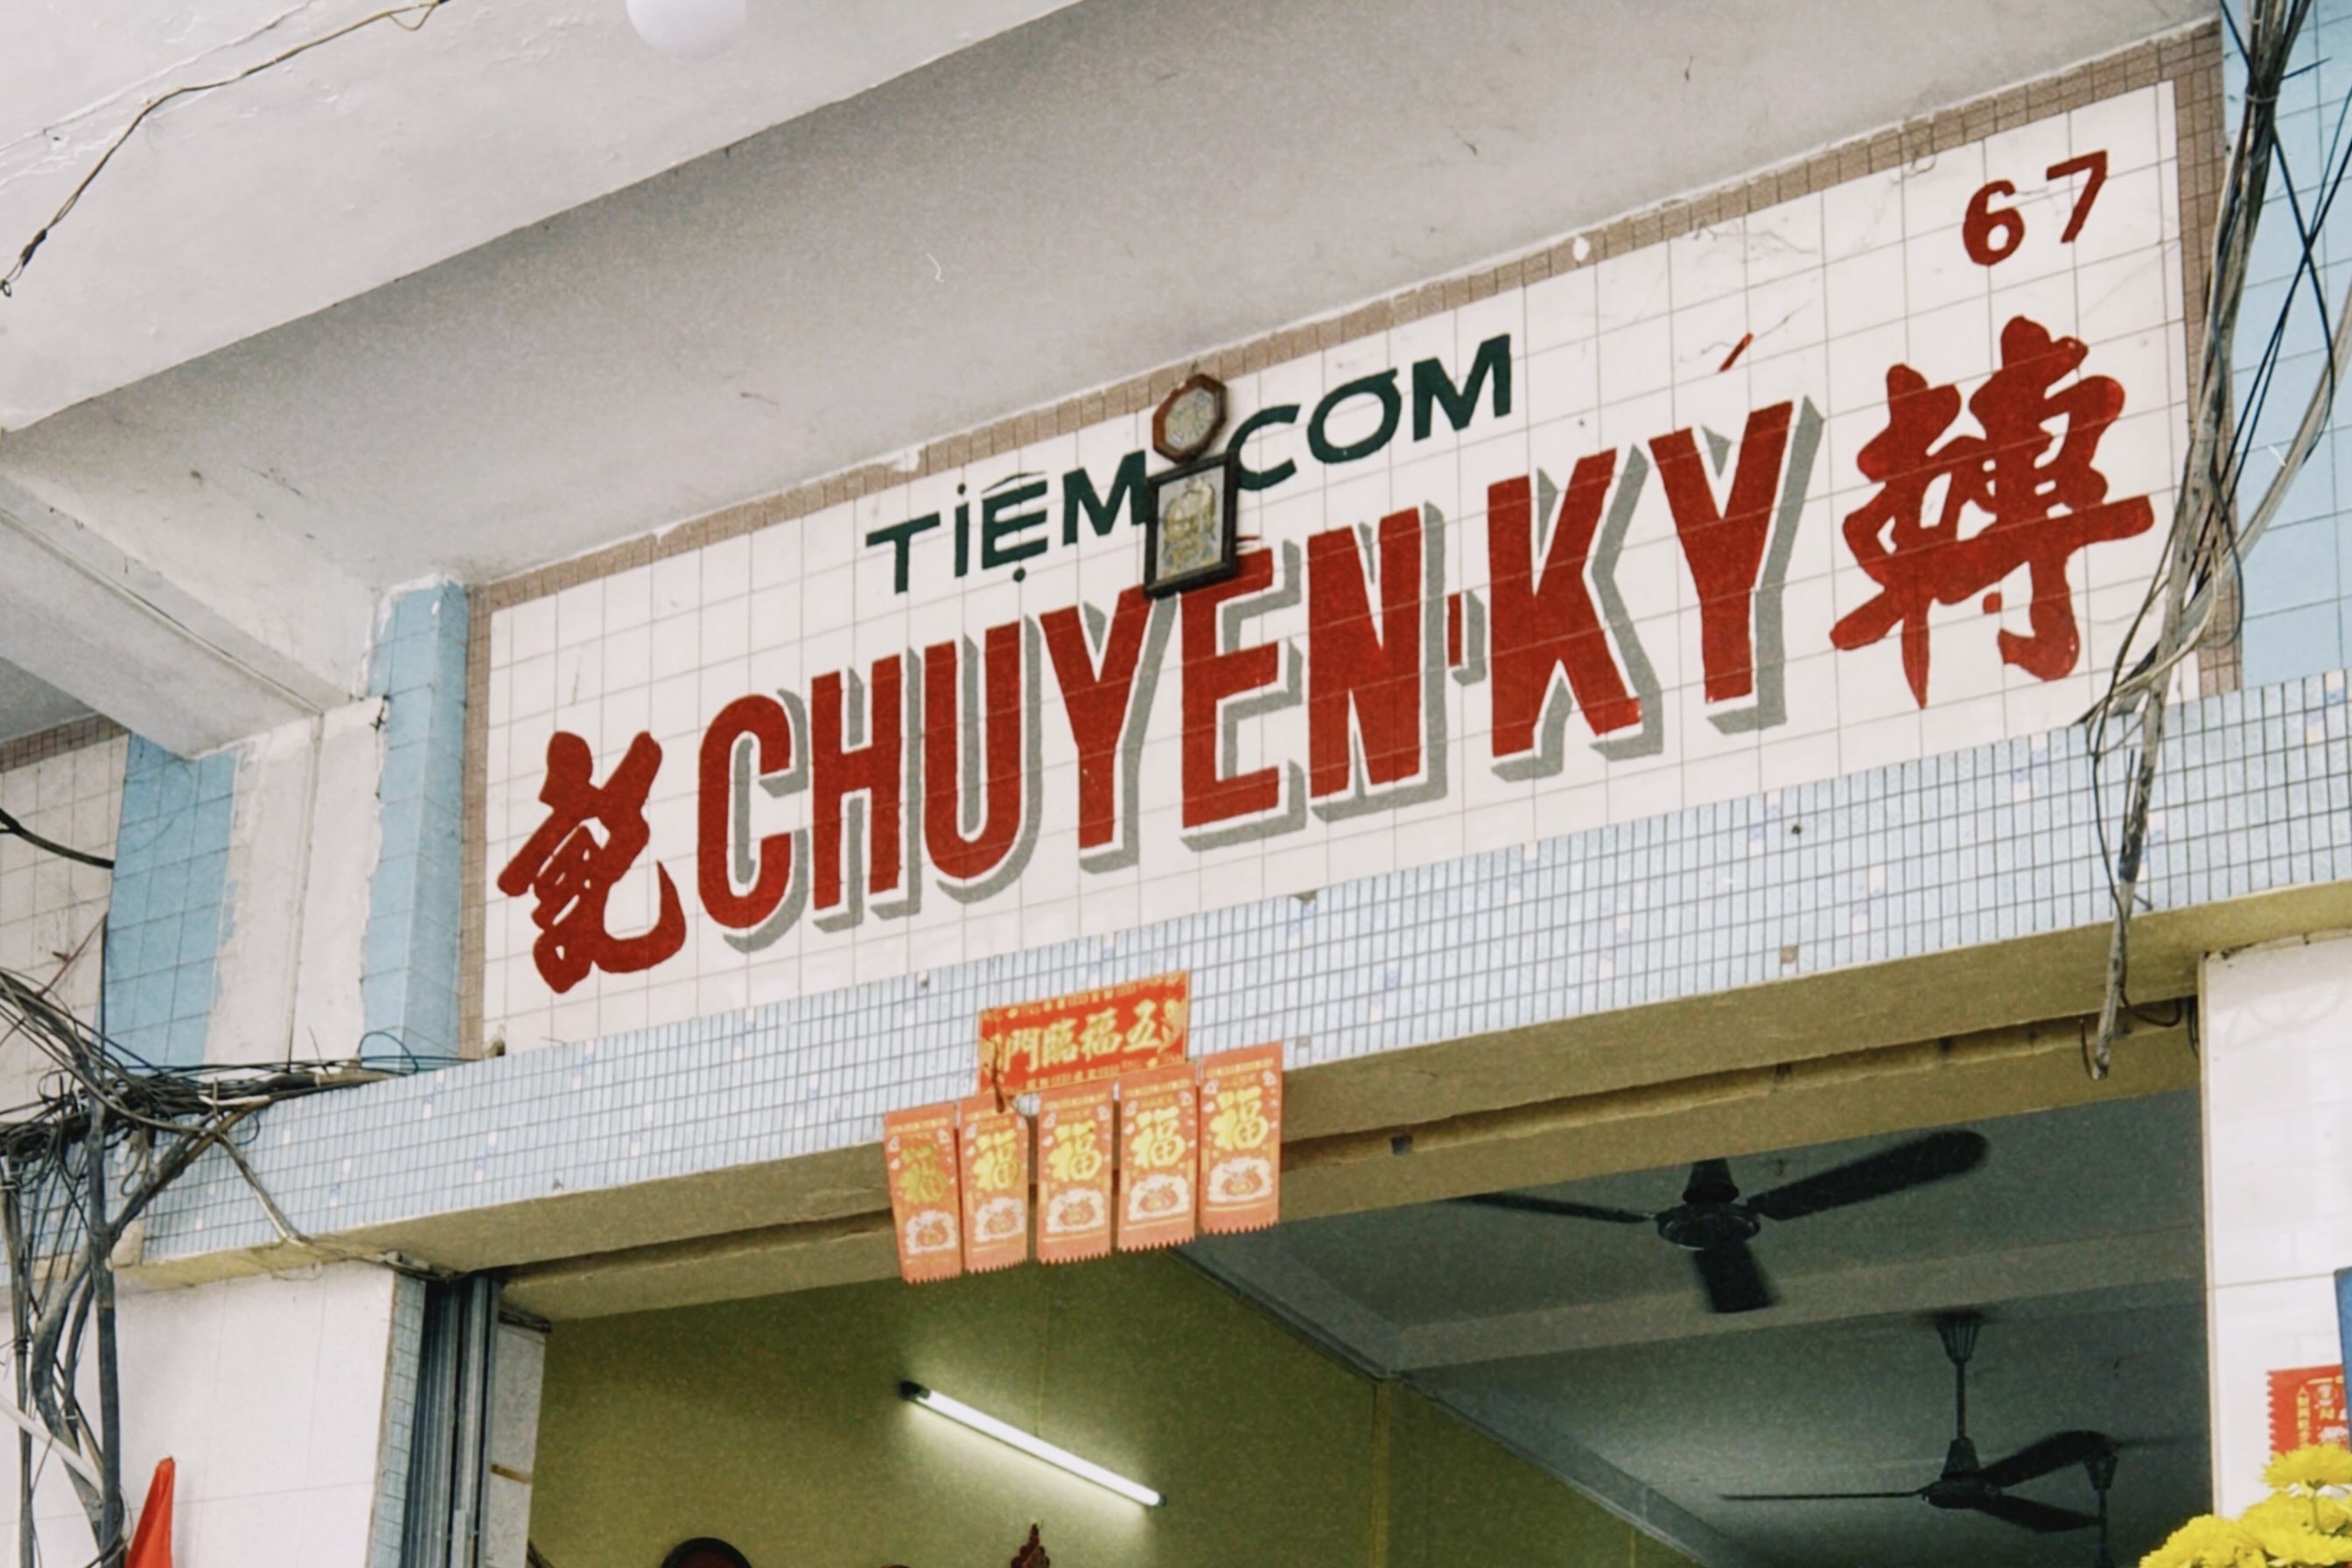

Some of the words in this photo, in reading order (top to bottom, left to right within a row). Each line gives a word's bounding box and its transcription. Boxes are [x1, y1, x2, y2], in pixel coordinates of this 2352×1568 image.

[1962, 149, 2109, 266] 67
[1226, 332, 1513, 493] CƠM
[1046, 1118, 1103, 1183] 福
[1130, 1105, 1186, 1169] 福
[1208, 1085, 1270, 1151] 福
